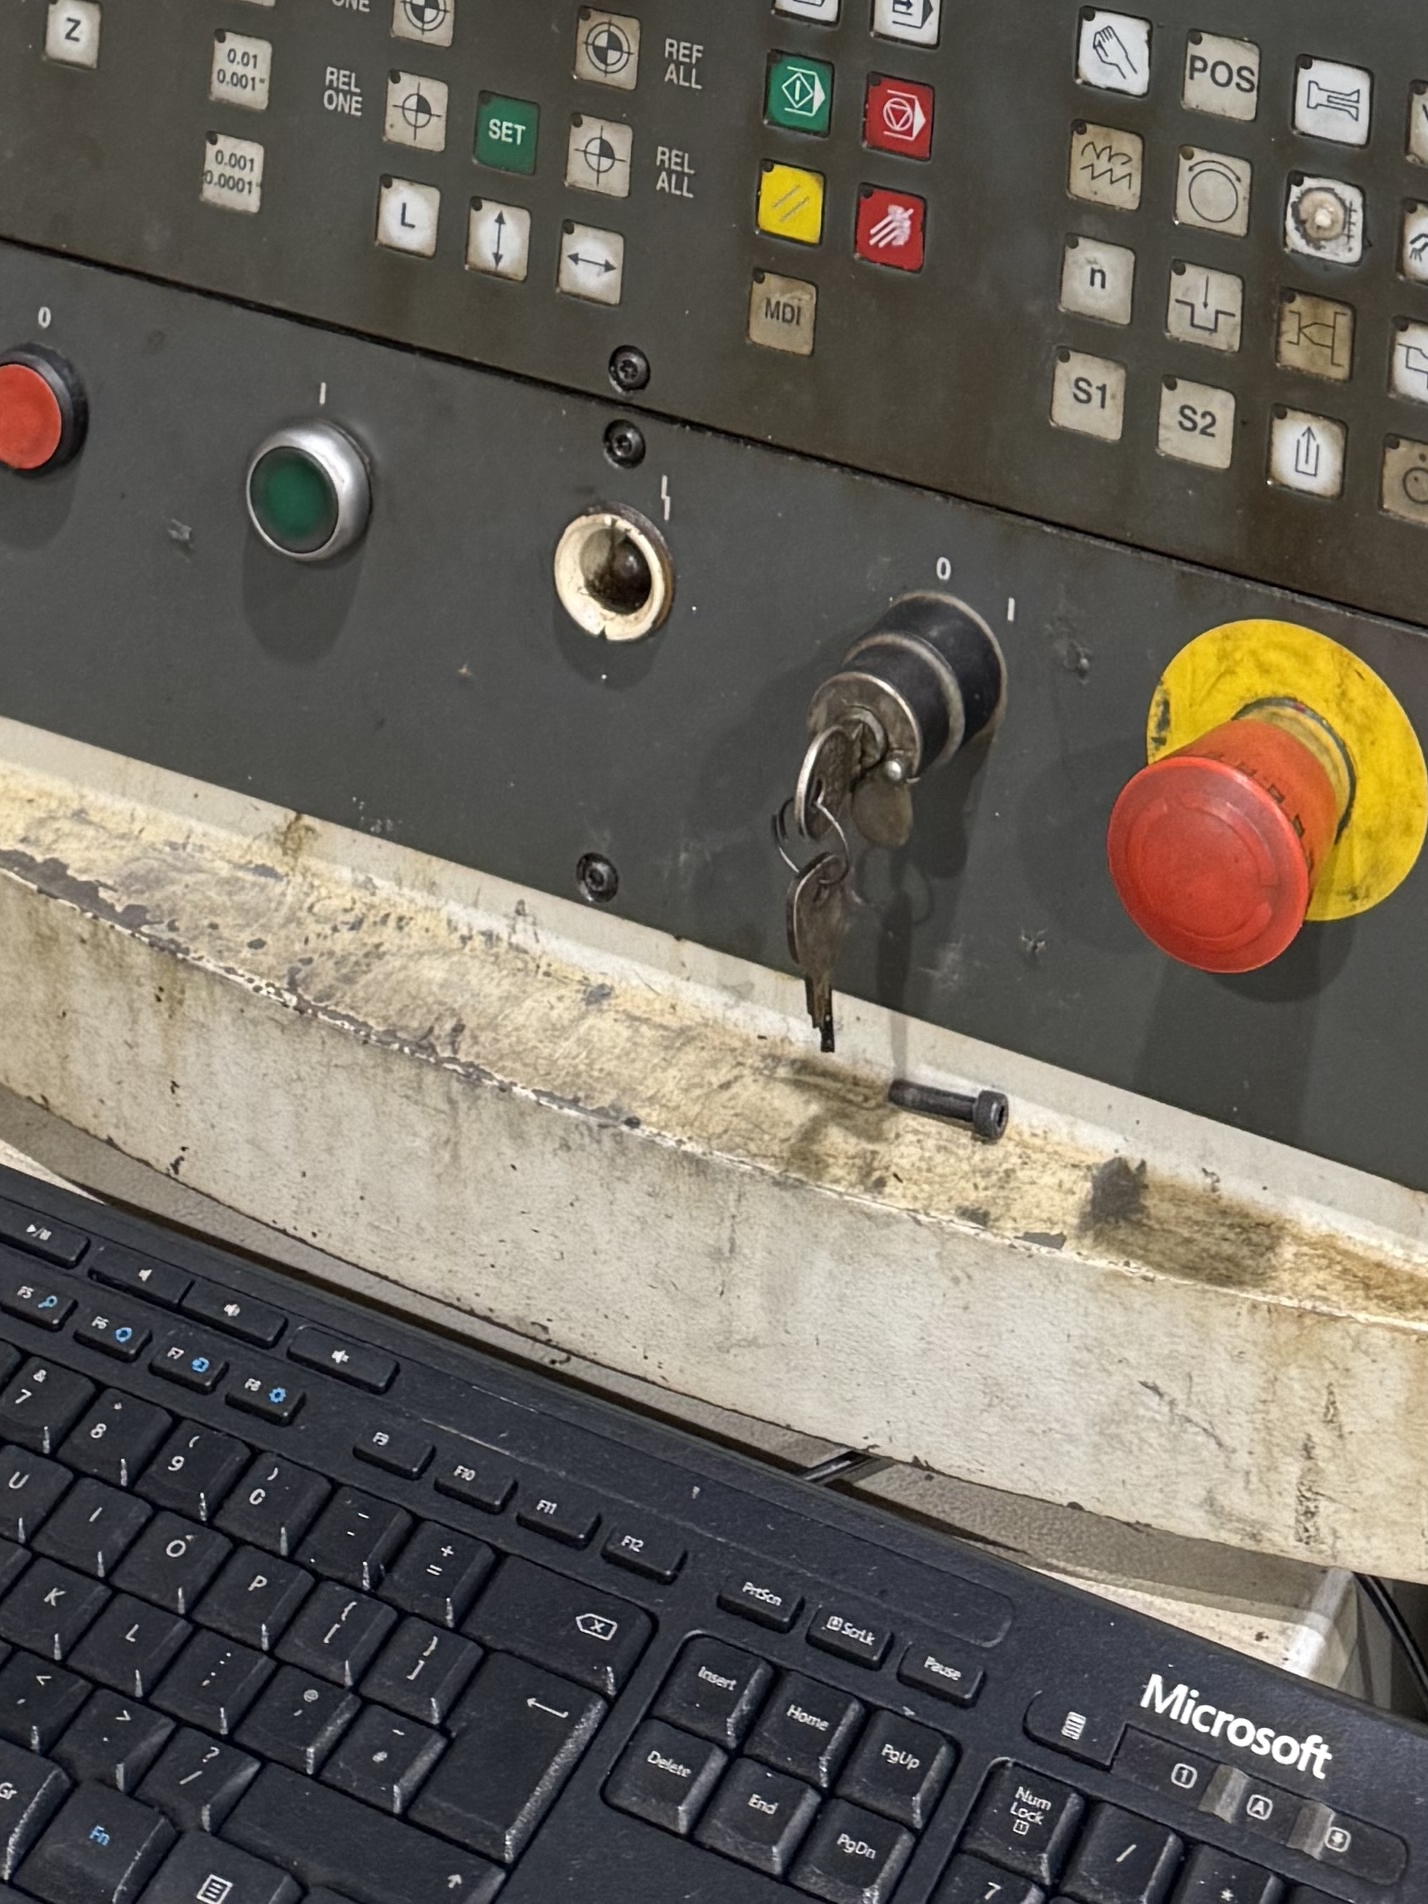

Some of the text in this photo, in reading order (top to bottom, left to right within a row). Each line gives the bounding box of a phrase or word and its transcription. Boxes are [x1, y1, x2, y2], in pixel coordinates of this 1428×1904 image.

[65, 18, 82, 42] Z
[226, 49, 259, 69] 0.01
[664, 38, 704, 64] REF
[325, 66, 361, 92] REL
[664, 62, 703, 90] ALL
[1188, 54, 1255, 93] POS
[323, 89, 363, 116] ONE
[488, 118, 526, 146] SET
[214, 150, 256, 173] 0.001
[656, 146, 695, 174] REL
[655, 170, 694, 198] ALL
[401, 202, 415, 228] L
[1089, 265, 1106, 289] n
[37, 306, 52, 328] 0
[764, 298, 801, 326] MDI
[1072, 377, 1108, 408] S1
[1178, 405, 1216, 439] S2
[936, 556, 951, 581] 0
[9, 1472, 29, 1489] U
[454, 1465, 476, 1481] F10
[536, 1500, 557, 1516] F11
[166, 1540, 186, 1558] O
[621, 1537, 645, 1553] F12
[249, 1575, 268, 1593] P
[697, 1666, 736, 1690] Insert
[923, 1656, 962, 1681] Pause
[786, 1704, 828, 1732] Home
[1140, 1674, 1332, 1780] Microsoft
[647, 1750, 691, 1778] Delete
[881, 1743, 919, 1770] PgUp
[749, 1794, 776, 1816] End
[1015, 1787, 1051, 1810] Num
[1010, 1804, 1043, 1825] Lock
[89, 1824, 110, 1847] Fn
[838, 1833, 876, 1859] PgDn
